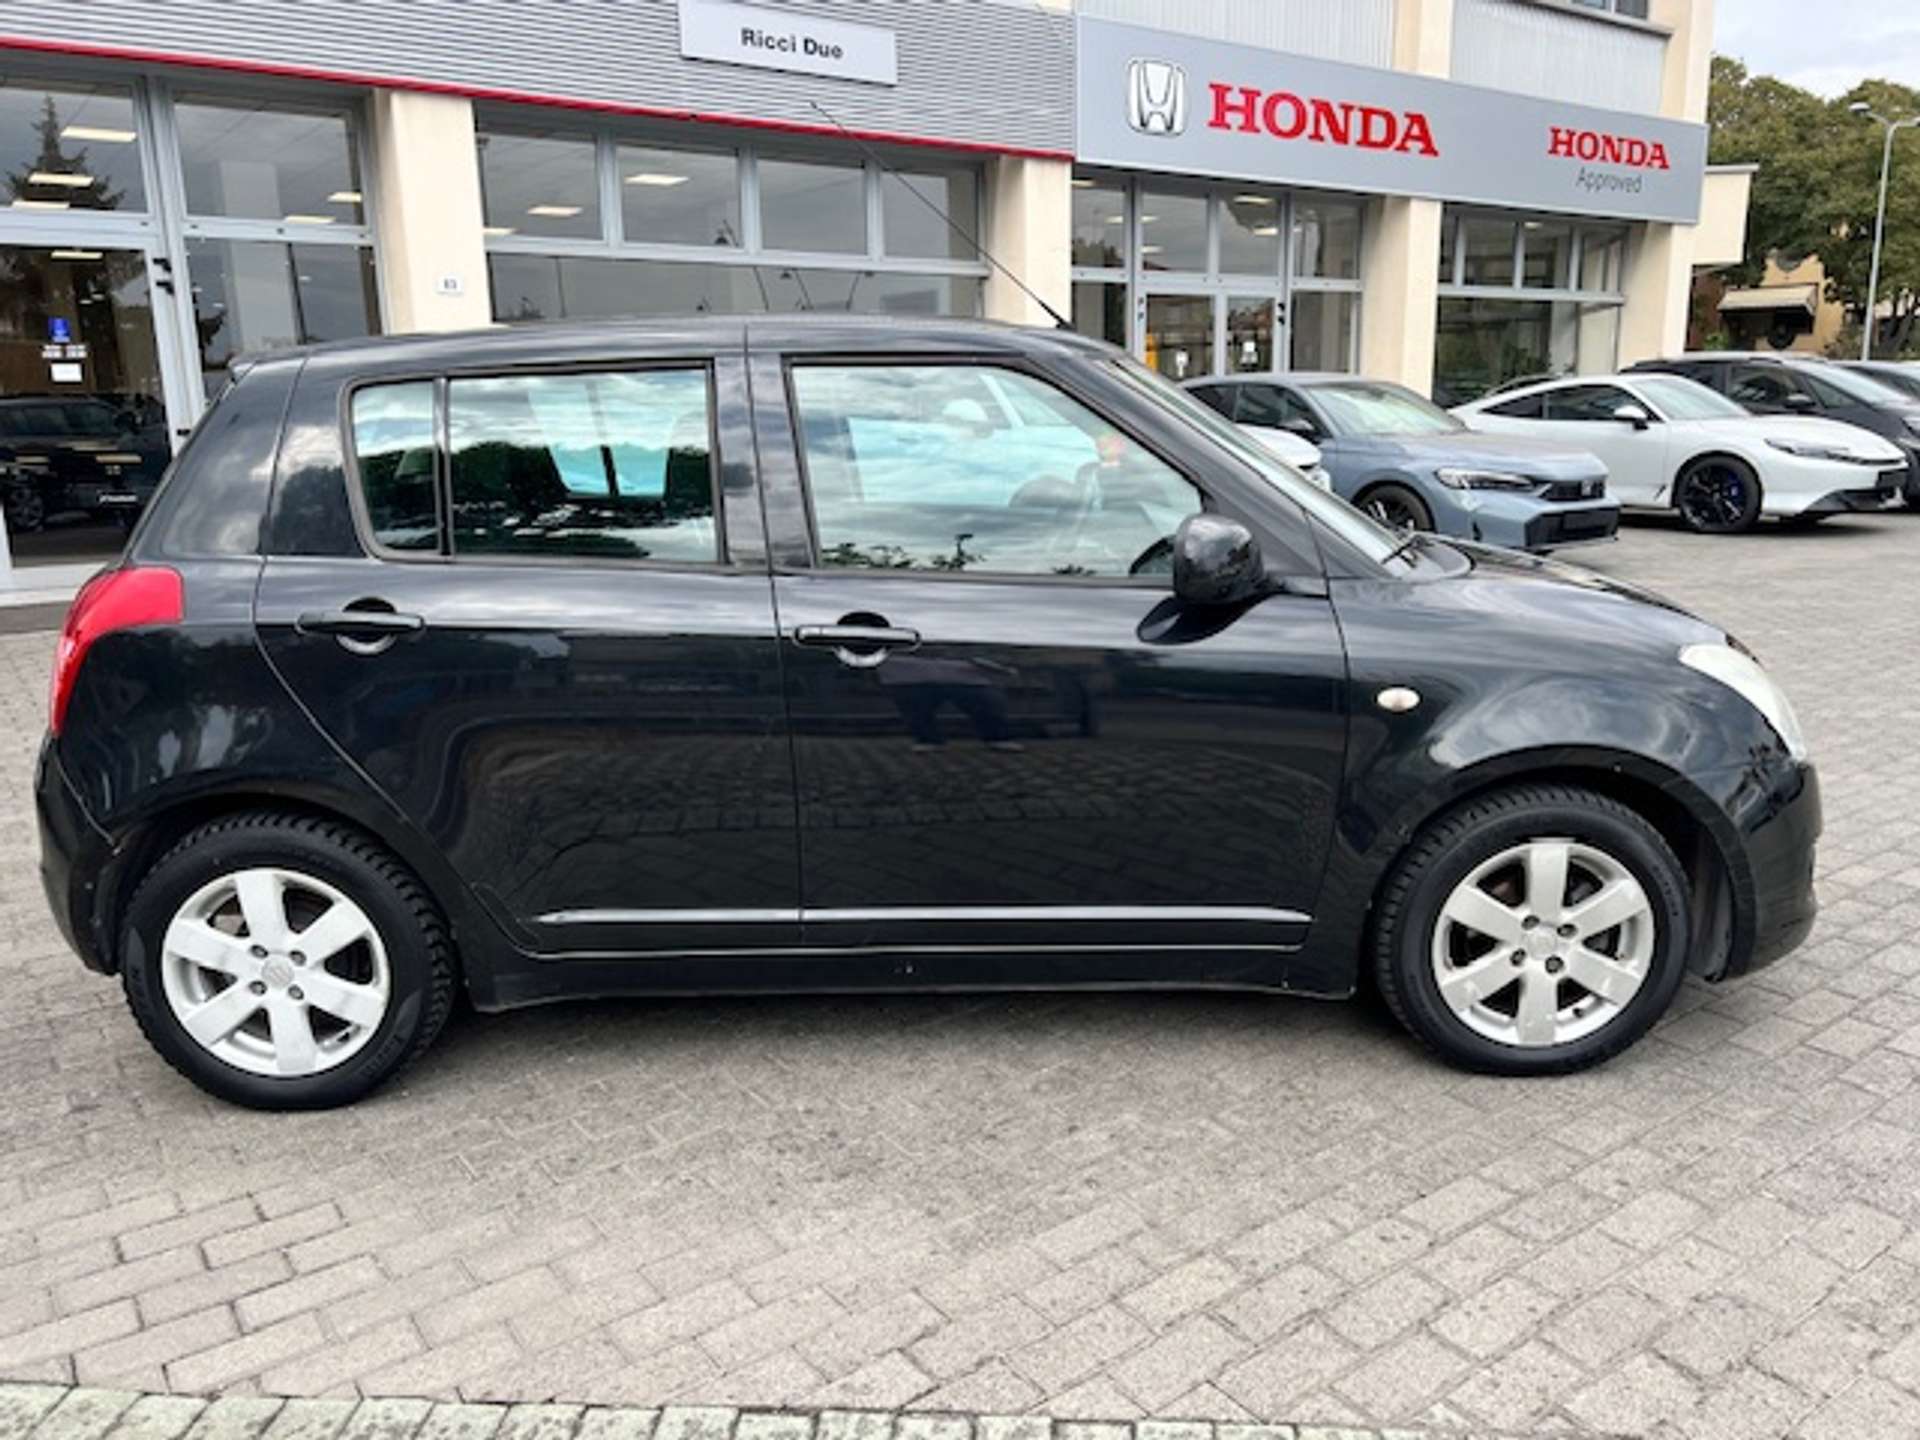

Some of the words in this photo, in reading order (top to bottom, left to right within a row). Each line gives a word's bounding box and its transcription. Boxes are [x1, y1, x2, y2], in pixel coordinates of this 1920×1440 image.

[741, 27, 796, 52] Ricci
[803, 37, 844, 59] Due
[1207, 83, 1439, 157] HONDA
[1547, 127, 1670, 169] HONDA
[1575, 167, 1642, 194] Approved
